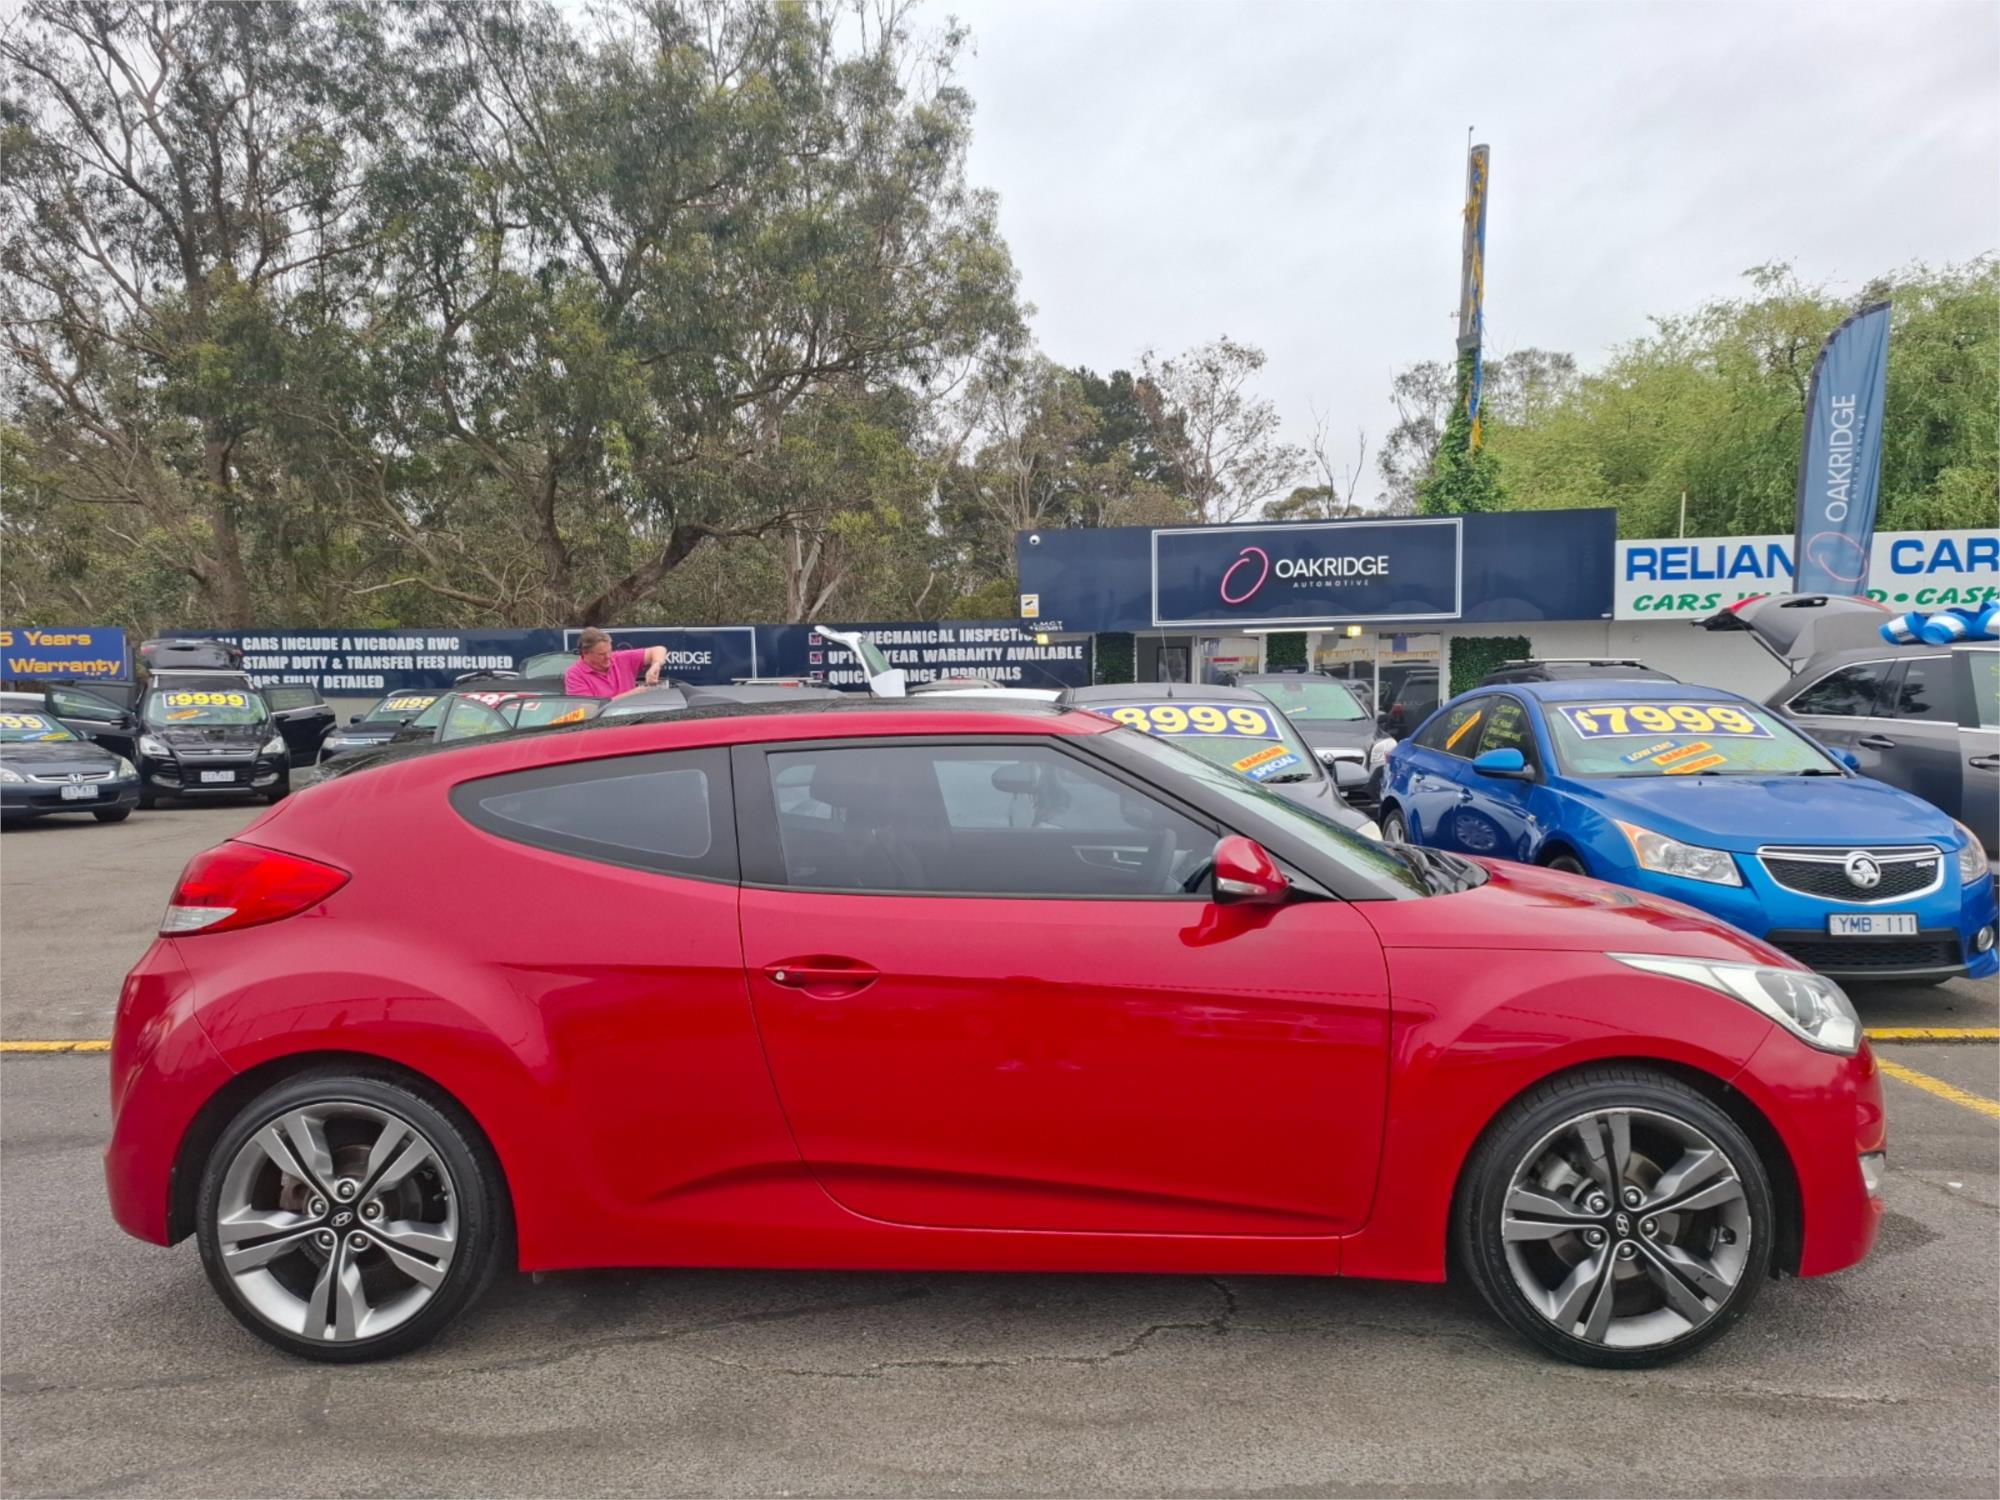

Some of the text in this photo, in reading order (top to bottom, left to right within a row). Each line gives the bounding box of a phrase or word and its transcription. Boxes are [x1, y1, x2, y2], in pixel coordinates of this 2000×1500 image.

[1825, 394, 1856, 522] OAKRIDGE
[1891, 537, 2000, 575] CAR
[1275, 556, 1389, 578] OAKRIDGE
[1293, 580, 1369, 588] AUTOMOTIVE
[1633, 592, 1721, 611] CARS
[23, 631, 92, 646] Years
[242, 637, 279, 651] CARS
[282, 637, 338, 651] INCLUDE
[342, 637, 351, 650] A
[354, 637, 424, 650] VICROADS
[427, 637, 460, 650] RWC
[243, 656, 513, 669] STAMP DUTY & TRANSFER FEES INCLUDED
[665, 651, 713, 665] KRIDGE
[884, 649, 919, 663] YEAR
[922, 647, 1003, 663] WARRANTY
[1006, 646, 1083, 661] AVAILABLE
[8, 658, 120, 675] Warranty
[250, 675, 280, 688] ARS
[323, 675, 384, 689] DETAILED
[828, 666, 1022, 685] QUIC ANCE APPROVALS
[167, 693, 244, 706] $9999
[1575, 706, 1755, 733] $7999
[1252, 754, 1297, 777] SPECIAL
[1839, 917, 1914, 932] YMB 111
